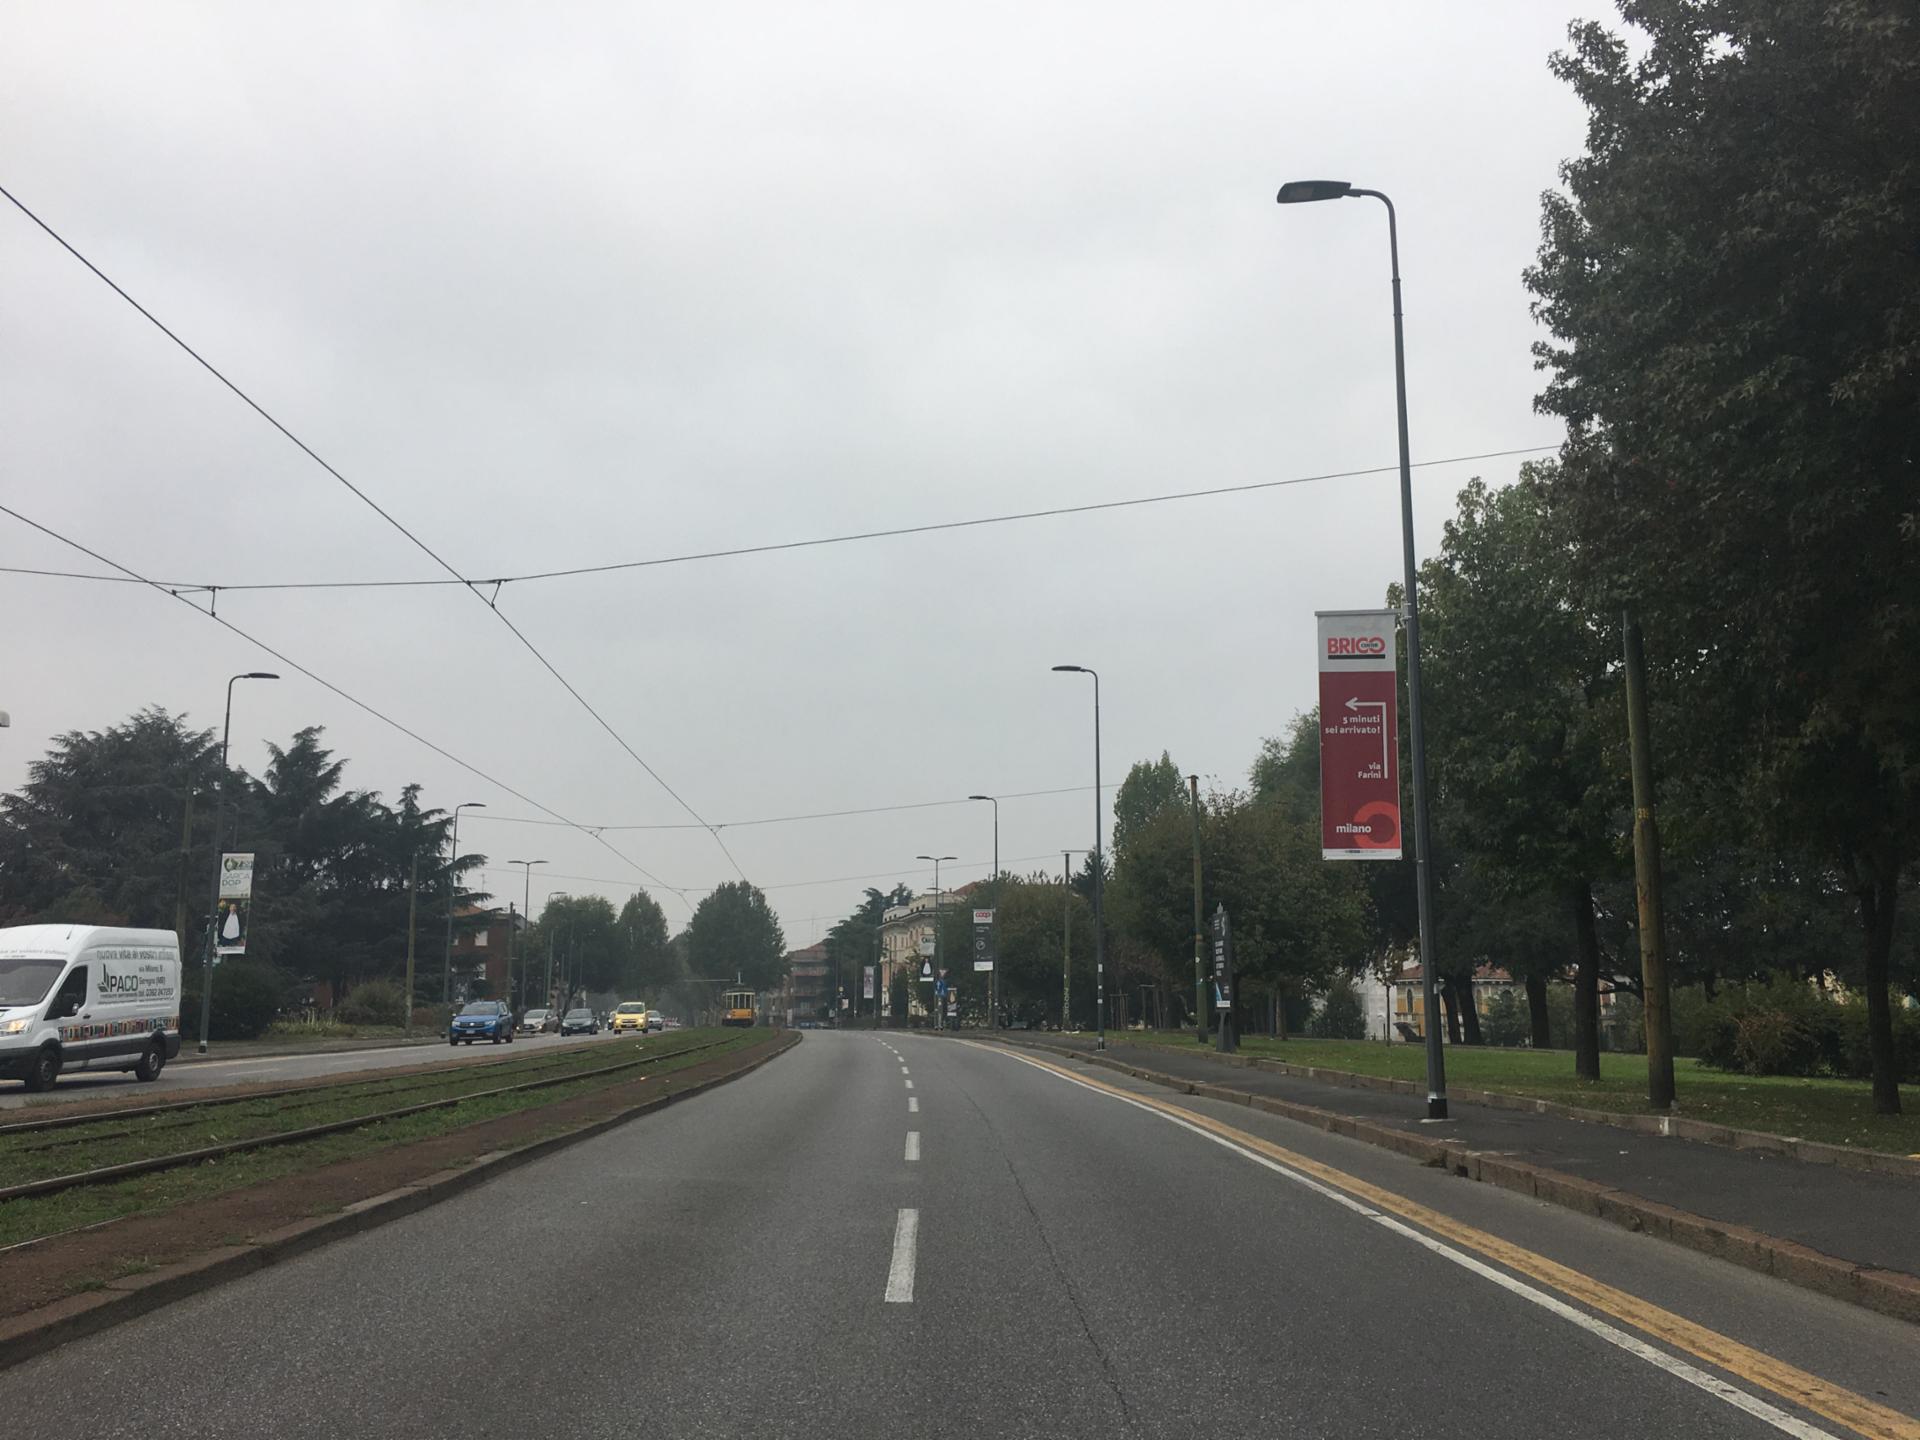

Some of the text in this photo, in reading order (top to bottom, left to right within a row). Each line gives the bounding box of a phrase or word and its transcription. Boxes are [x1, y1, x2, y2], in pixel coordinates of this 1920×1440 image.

[1328, 637, 1385, 654] BRICO
[1342, 715, 1380, 725] 5 minuti
[1325, 725, 1381, 735] sei arrivato!
[1368, 761, 1381, 771] via
[1358, 770, 1382, 780] Farini
[1336, 825, 1372, 834] milano
[110, 975, 138, 992] PACO
